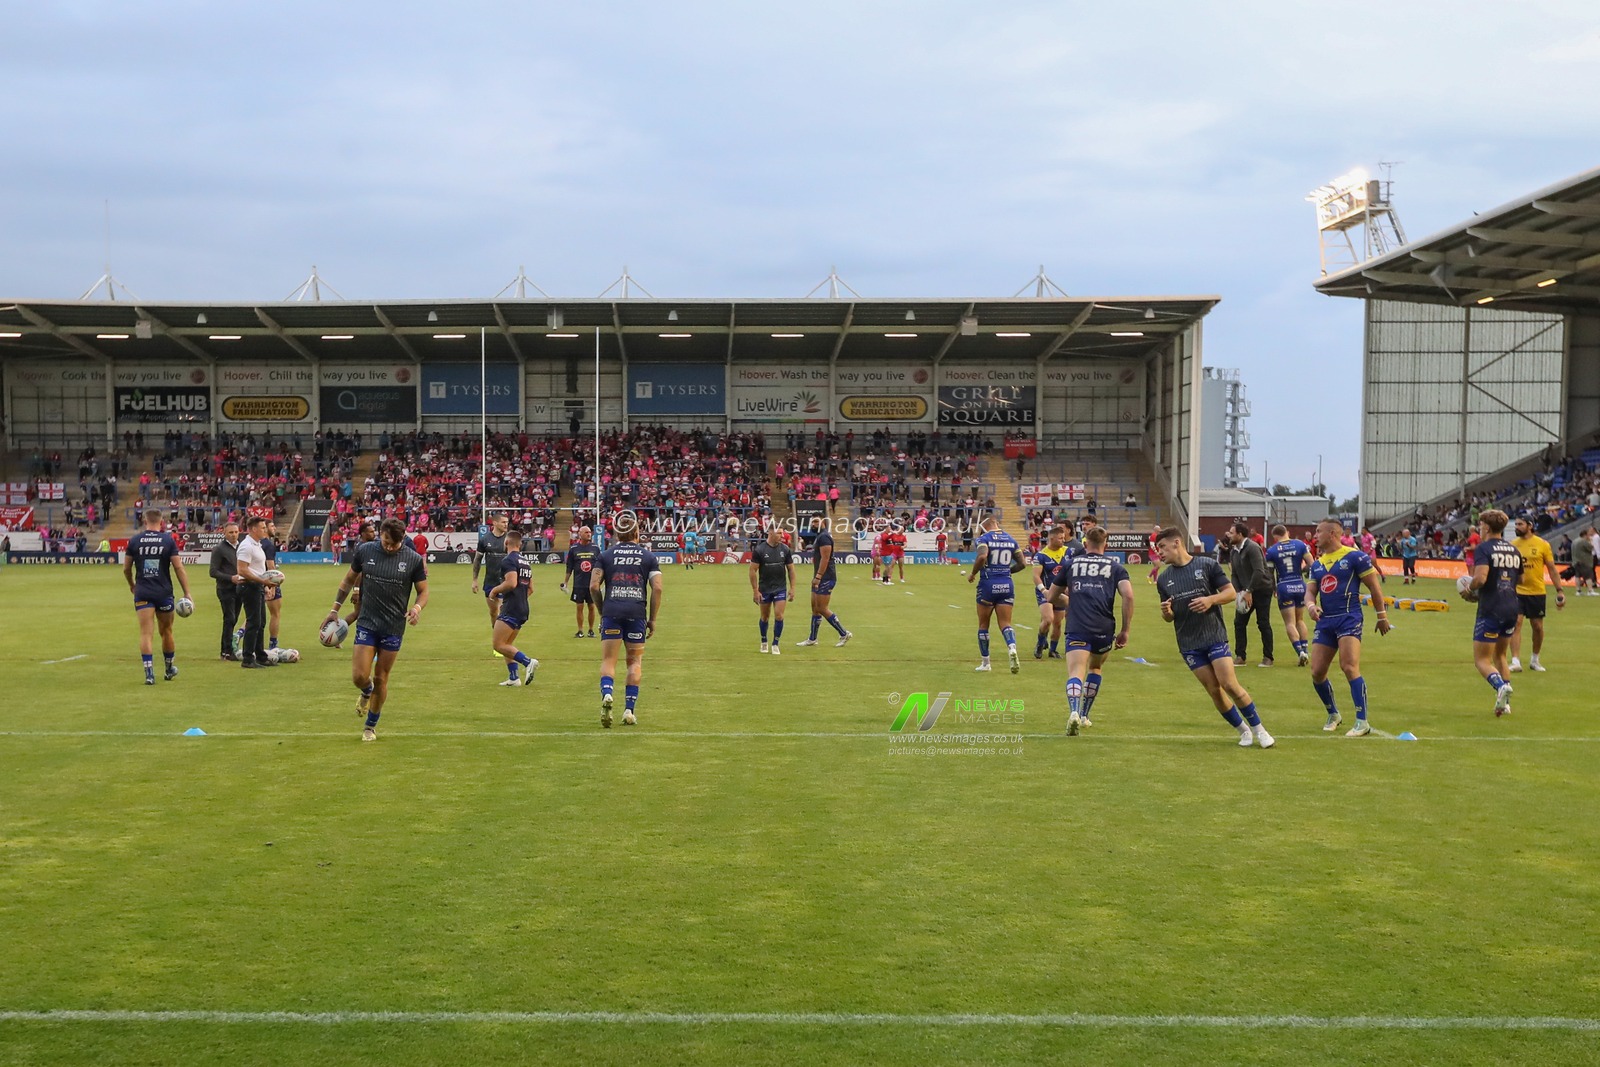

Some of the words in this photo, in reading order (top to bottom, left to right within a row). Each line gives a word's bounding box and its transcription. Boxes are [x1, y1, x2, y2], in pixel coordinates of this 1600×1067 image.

[61, 370, 87, 380] Cook
[91, 370, 107, 380] the
[117, 372, 137, 382] way
[141, 372, 159, 382] you
[163, 370, 182, 380] live
[224, 371, 263, 380] Hoover.
[269, 370, 292, 380] Chill
[296, 370, 313, 380] the
[323, 371, 343, 381] way
[347, 371, 365, 381] you
[369, 370, 387, 380] live
[739, 370, 778, 379] Hoover.
[781, 370, 808, 379] Wash
[812, 370, 829, 379] the
[839, 372, 859, 382] way
[863, 372, 882, 382] you
[886, 370, 905, 380] live
[945, 370, 984, 380] Hoover.
[987, 370, 1016, 380] Clean
[1018, 370, 1036, 380] the
[1047, 372, 1067, 381] way
[1071, 372, 1089, 381] you
[1093, 370, 1112, 380] live
[450, 384, 512, 396] TYSERS
[657, 384, 718, 395] TYSERS
[120, 393, 207, 411] FUELHUB
[232, 401, 299, 409] WARRINGTON
[737, 398, 798, 412] LiveWire
[232, 408, 299, 416] FABRICATIONS
[535, 405, 545, 414] W
[850, 408, 918, 416] FABRICATIONS
[940, 409, 1034, 425] SQUARE
[20, 556, 57, 565] TETLEY'S
[69, 556, 105, 565] TETLEY'S
[613, 556, 642, 566] 1202
[990, 549, 1012, 565] 10
[1491, 553, 1521, 569] 1200
[1282, 556, 1294, 573] 1
[1071, 562, 1112, 579] 1184
